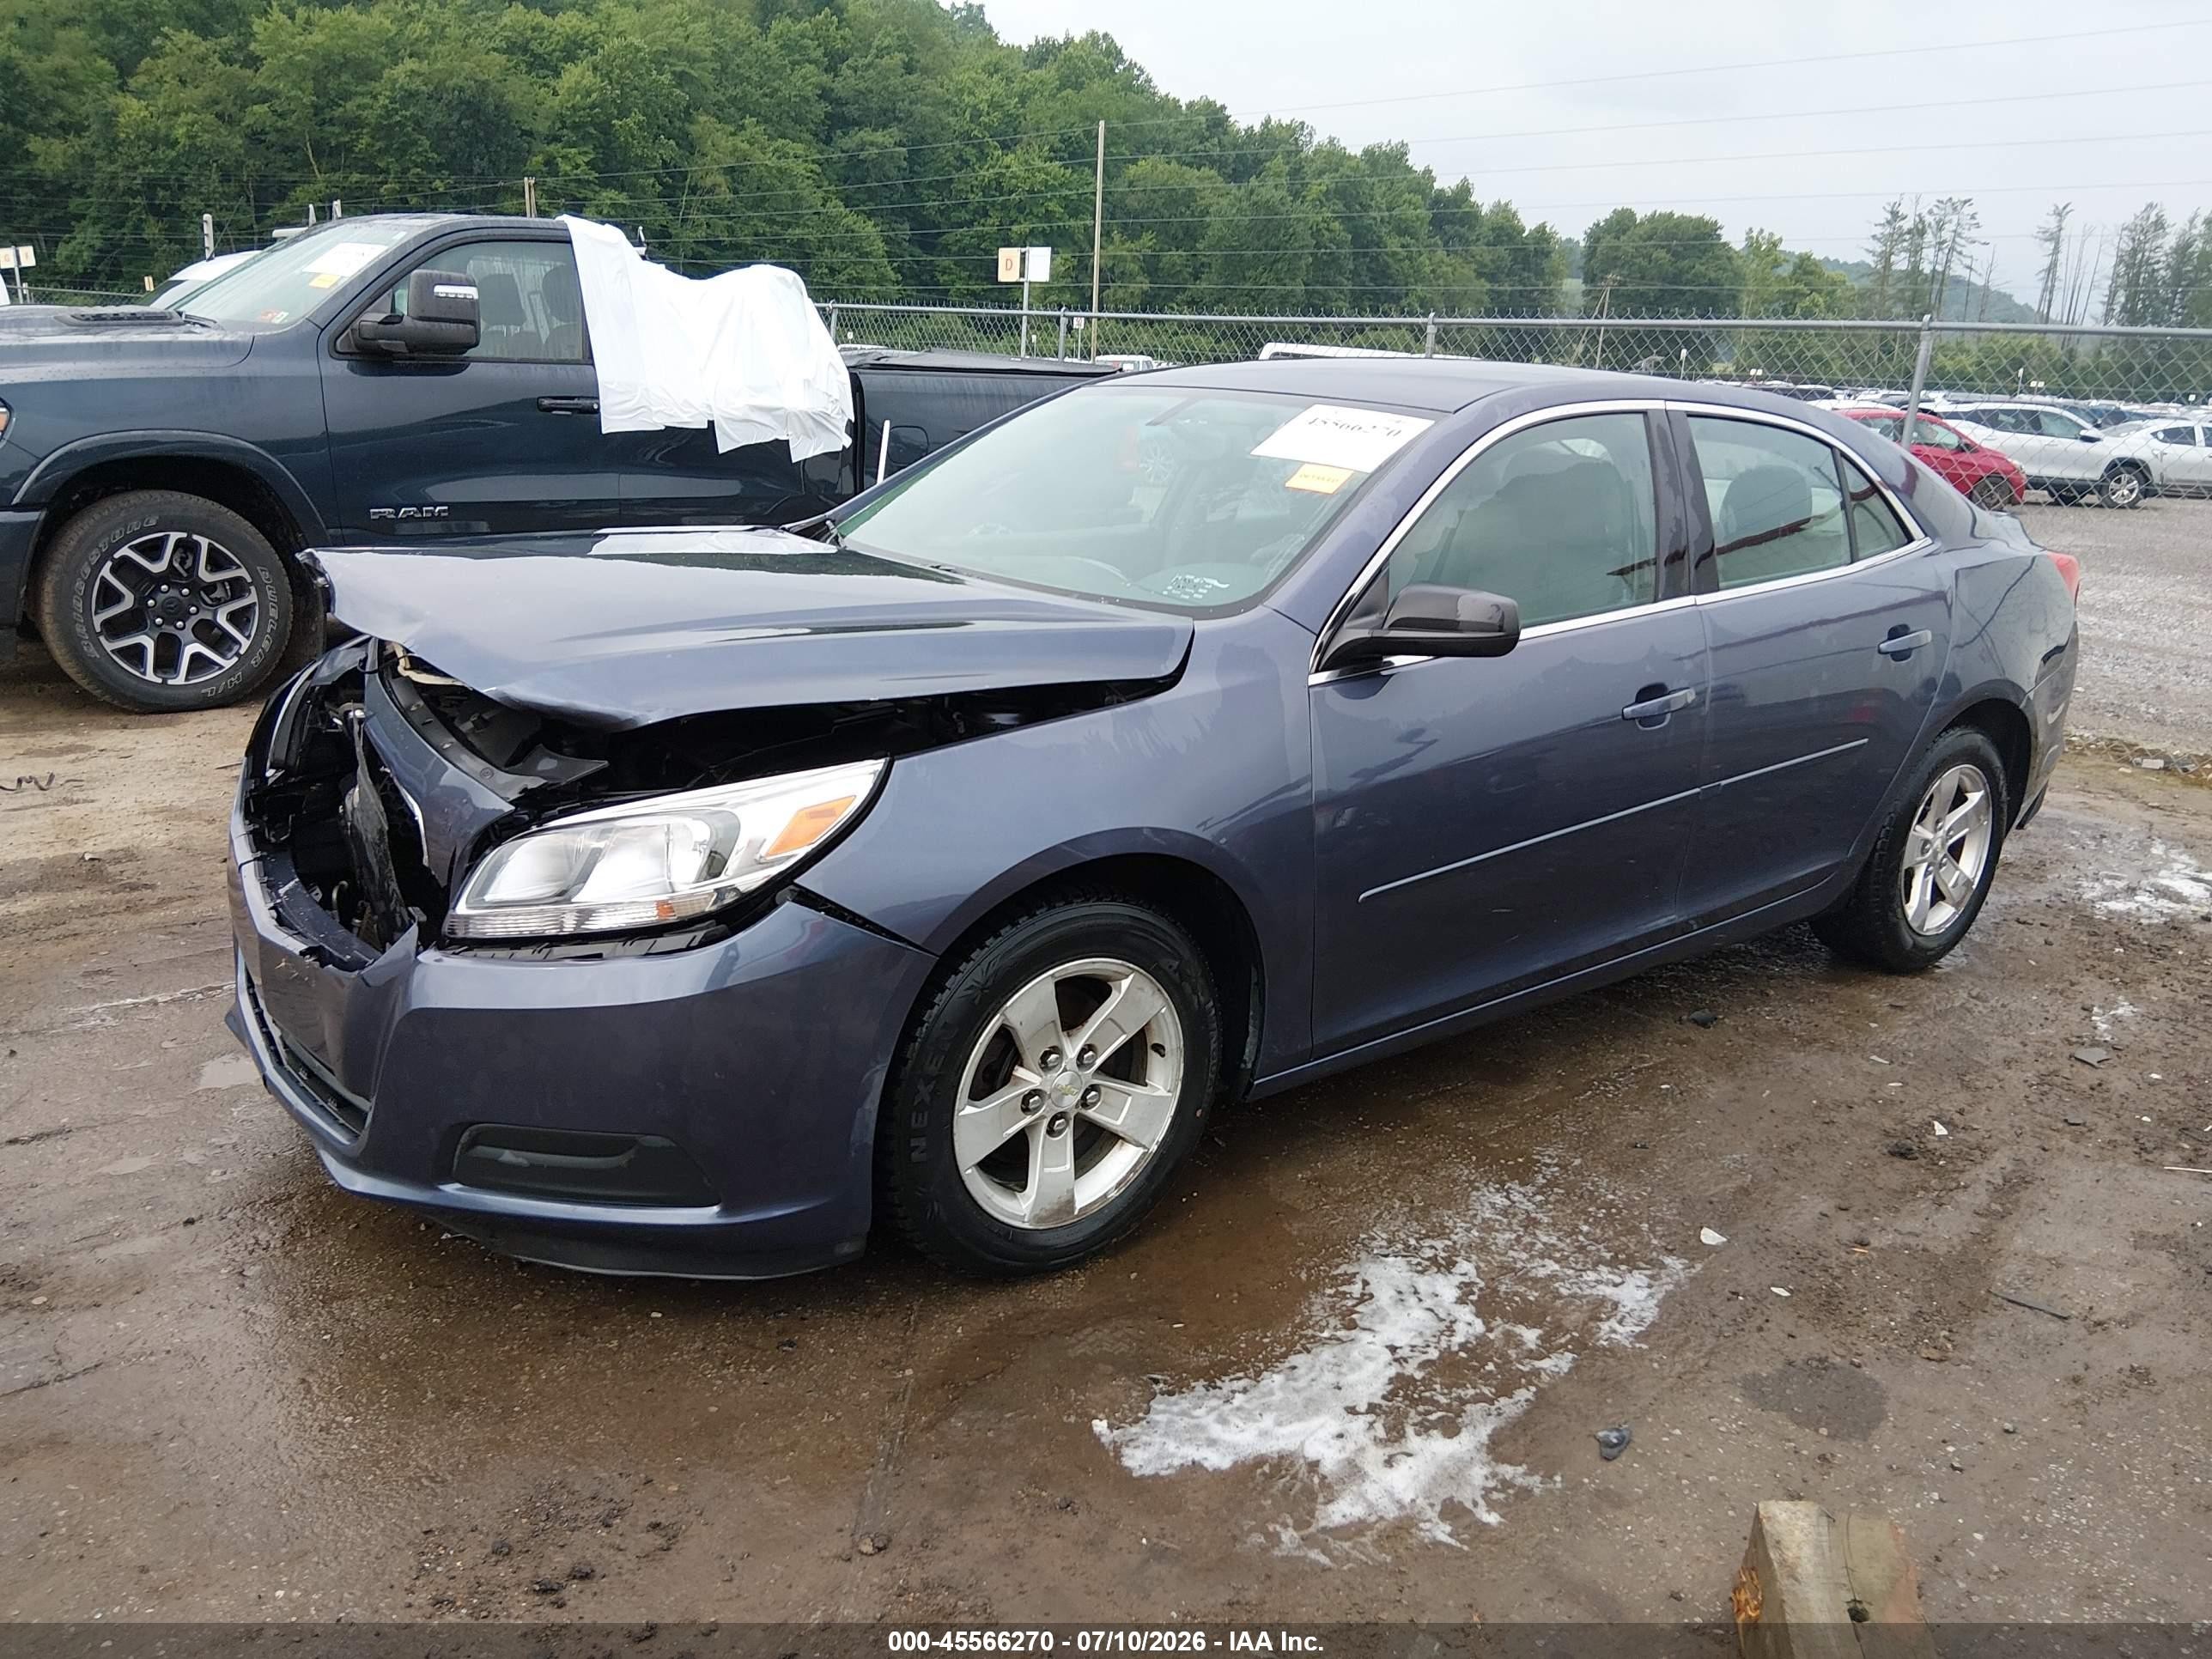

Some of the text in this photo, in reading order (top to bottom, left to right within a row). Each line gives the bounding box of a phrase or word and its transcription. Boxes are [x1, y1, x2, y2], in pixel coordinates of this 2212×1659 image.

[1005, 258, 1013, 271] D
[369, 506, 448, 520] RAM
[72, 515, 159, 659] BRIDGESTONE
[251, 566, 279, 668] DUELER
